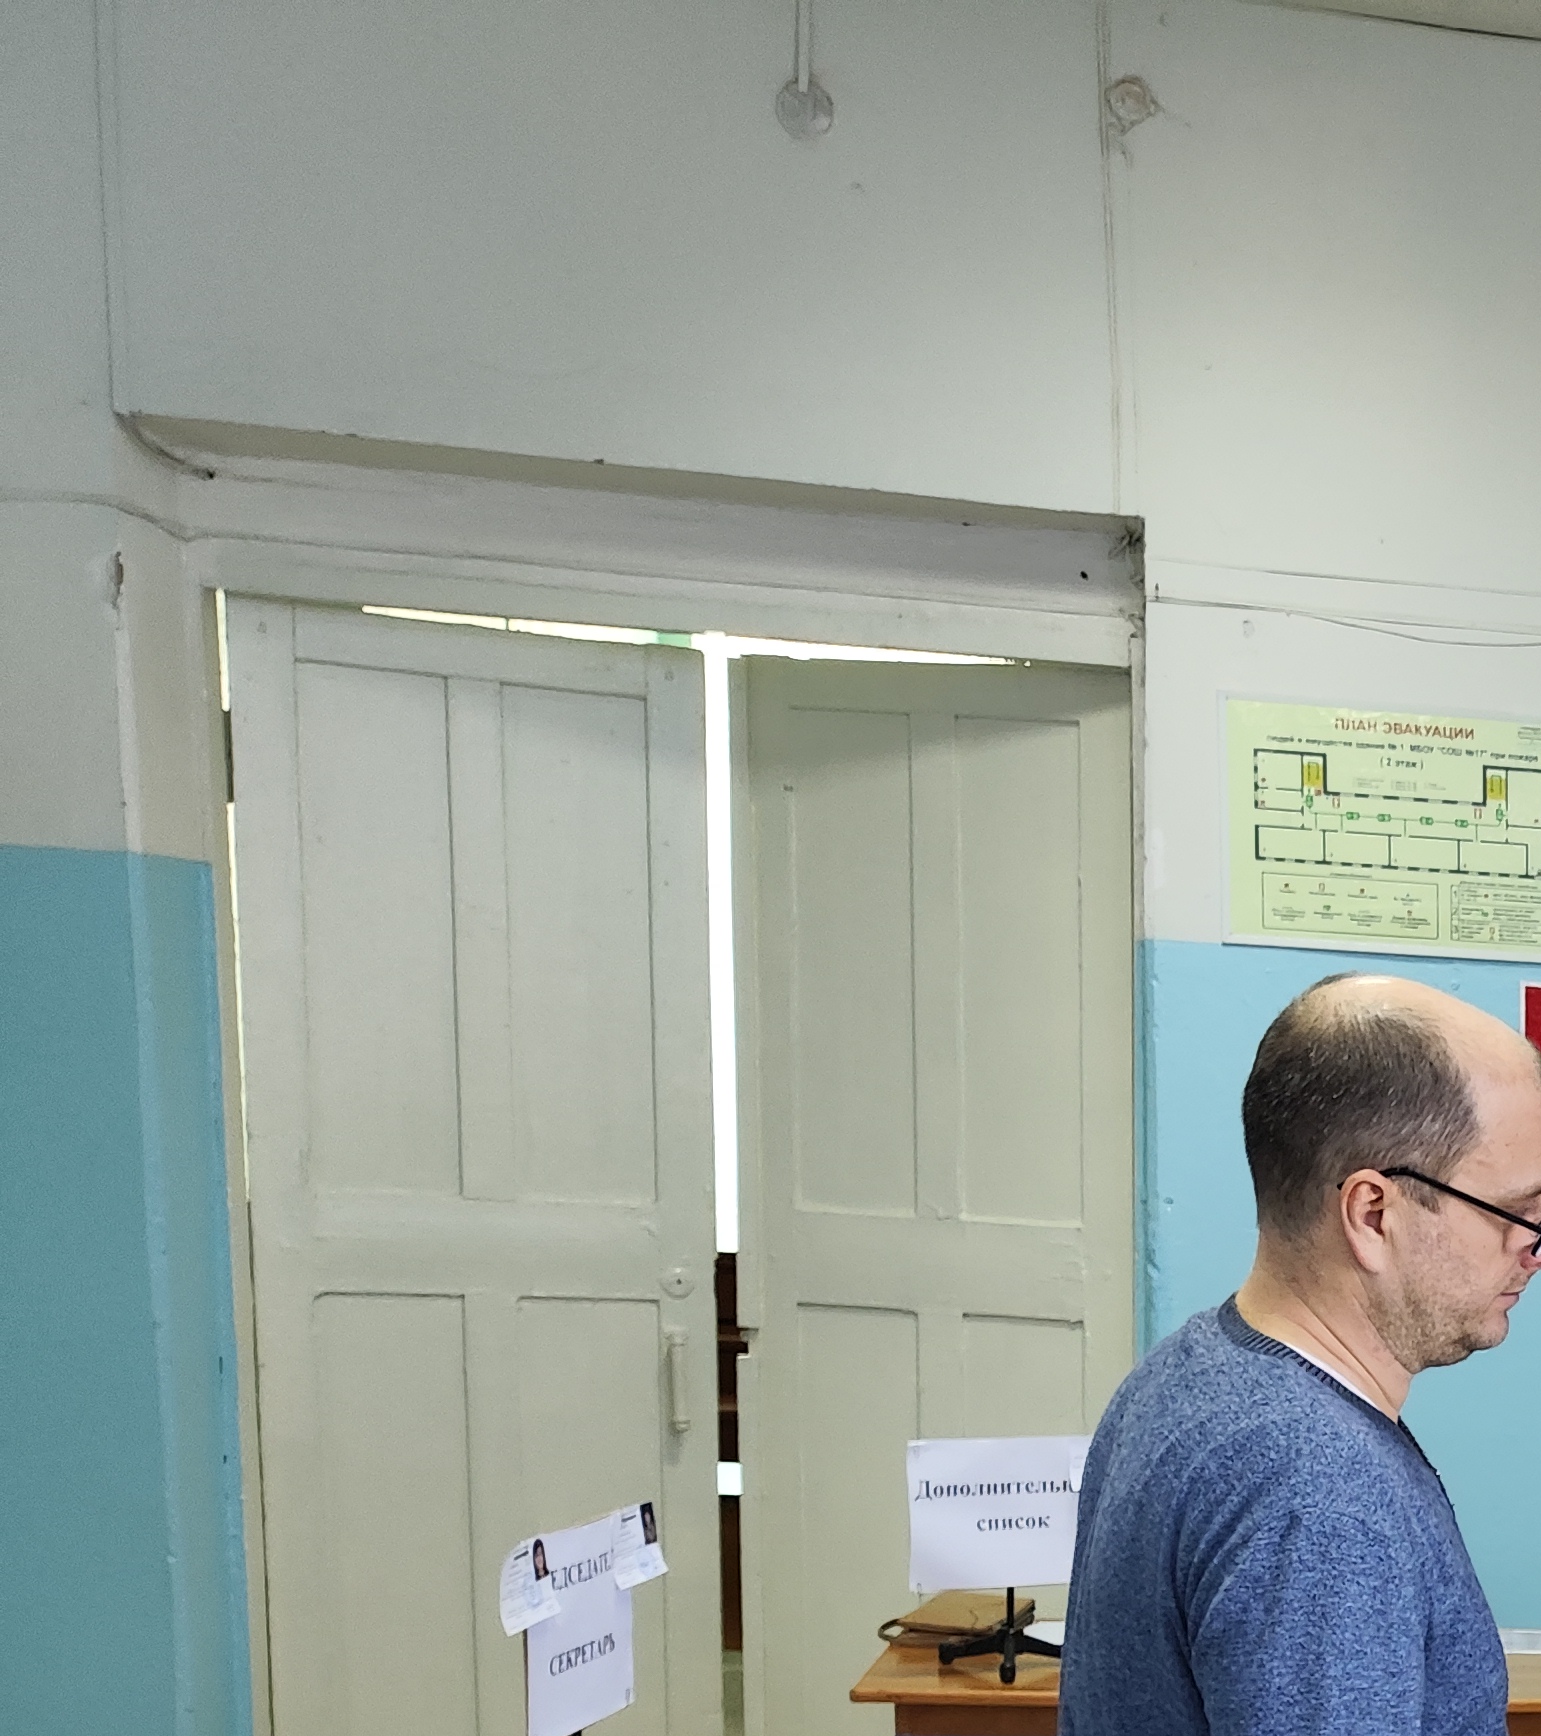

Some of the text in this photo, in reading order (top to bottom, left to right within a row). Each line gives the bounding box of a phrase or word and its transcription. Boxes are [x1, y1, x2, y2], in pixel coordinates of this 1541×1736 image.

[1335, 718, 1474, 740] ПЛАН ЭВАКУАЦИИ
[976, 1515, 1051, 1532] список
[550, 1633, 615, 1677] СЕКРЕТАРЬ
